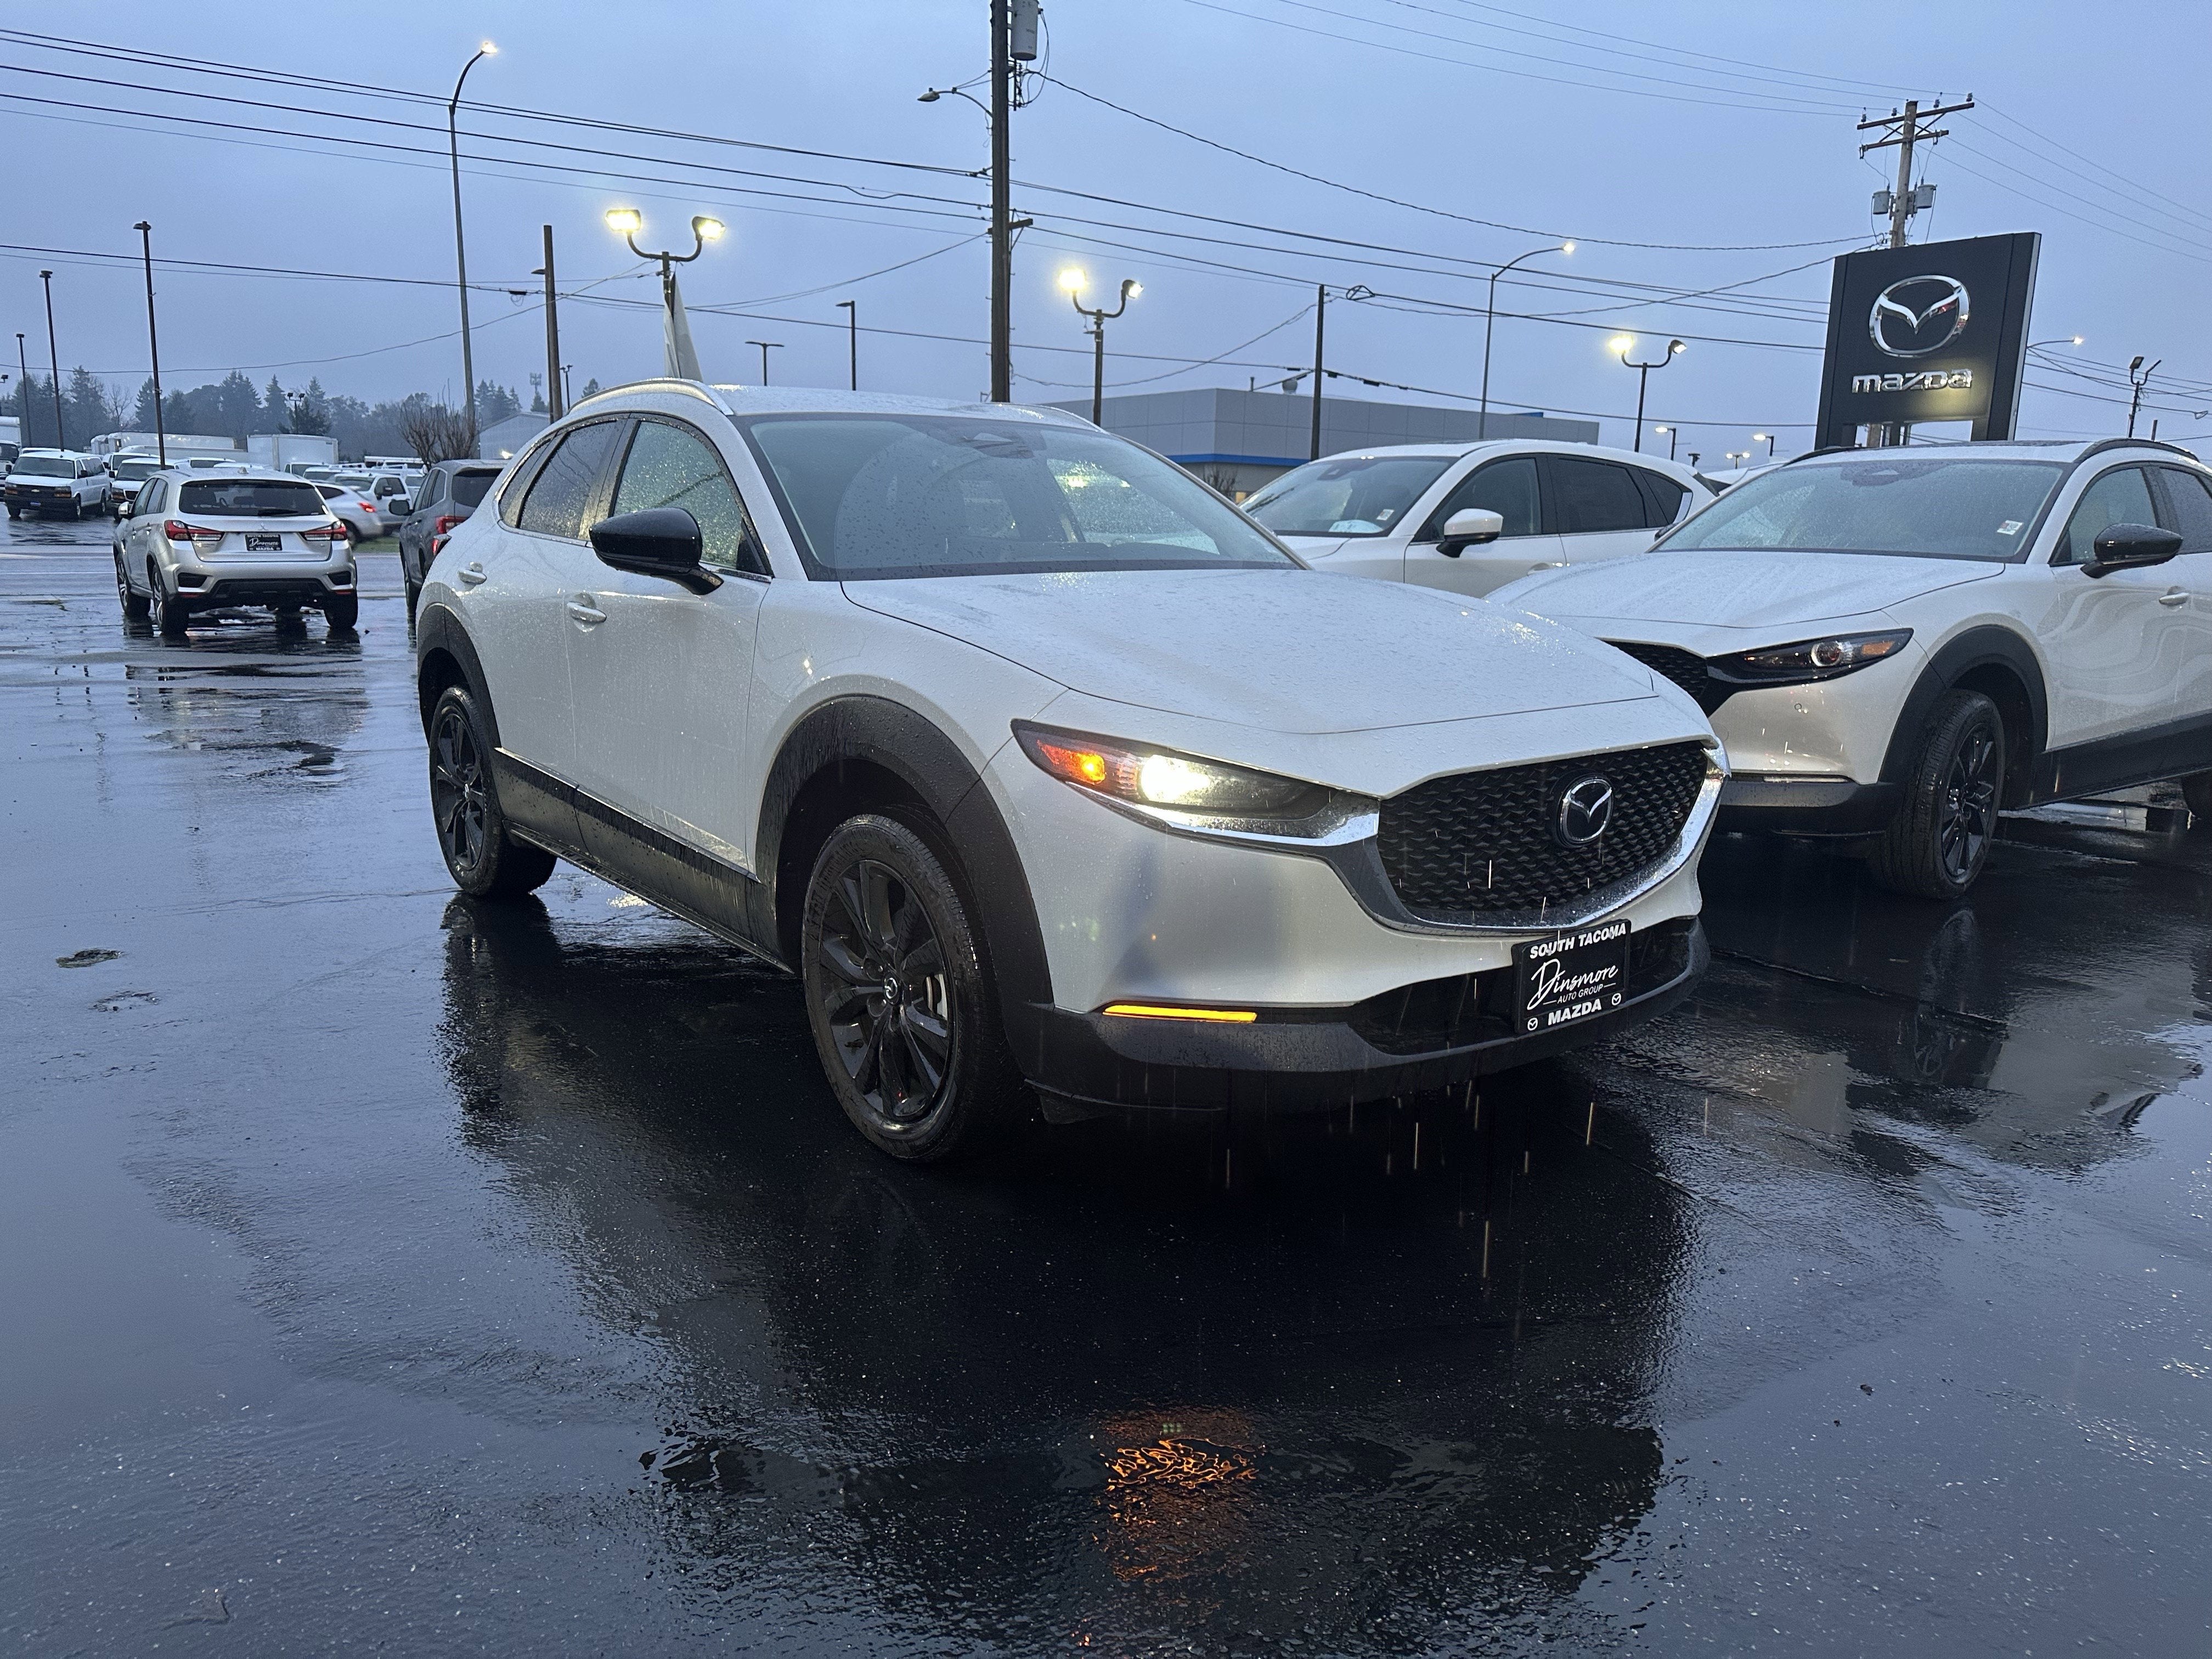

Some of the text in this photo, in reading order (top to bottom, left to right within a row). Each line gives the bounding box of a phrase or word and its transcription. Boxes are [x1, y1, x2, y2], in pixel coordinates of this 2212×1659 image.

[1852, 369, 1973, 393] mazda
[1530, 923, 1626, 959] SOUTH TACOMA
[1527, 958, 1618, 1011] Dinsmore
[1557, 984, 1604, 1004] AUTO GROUP
[1548, 998, 1602, 1025] MAZDA
